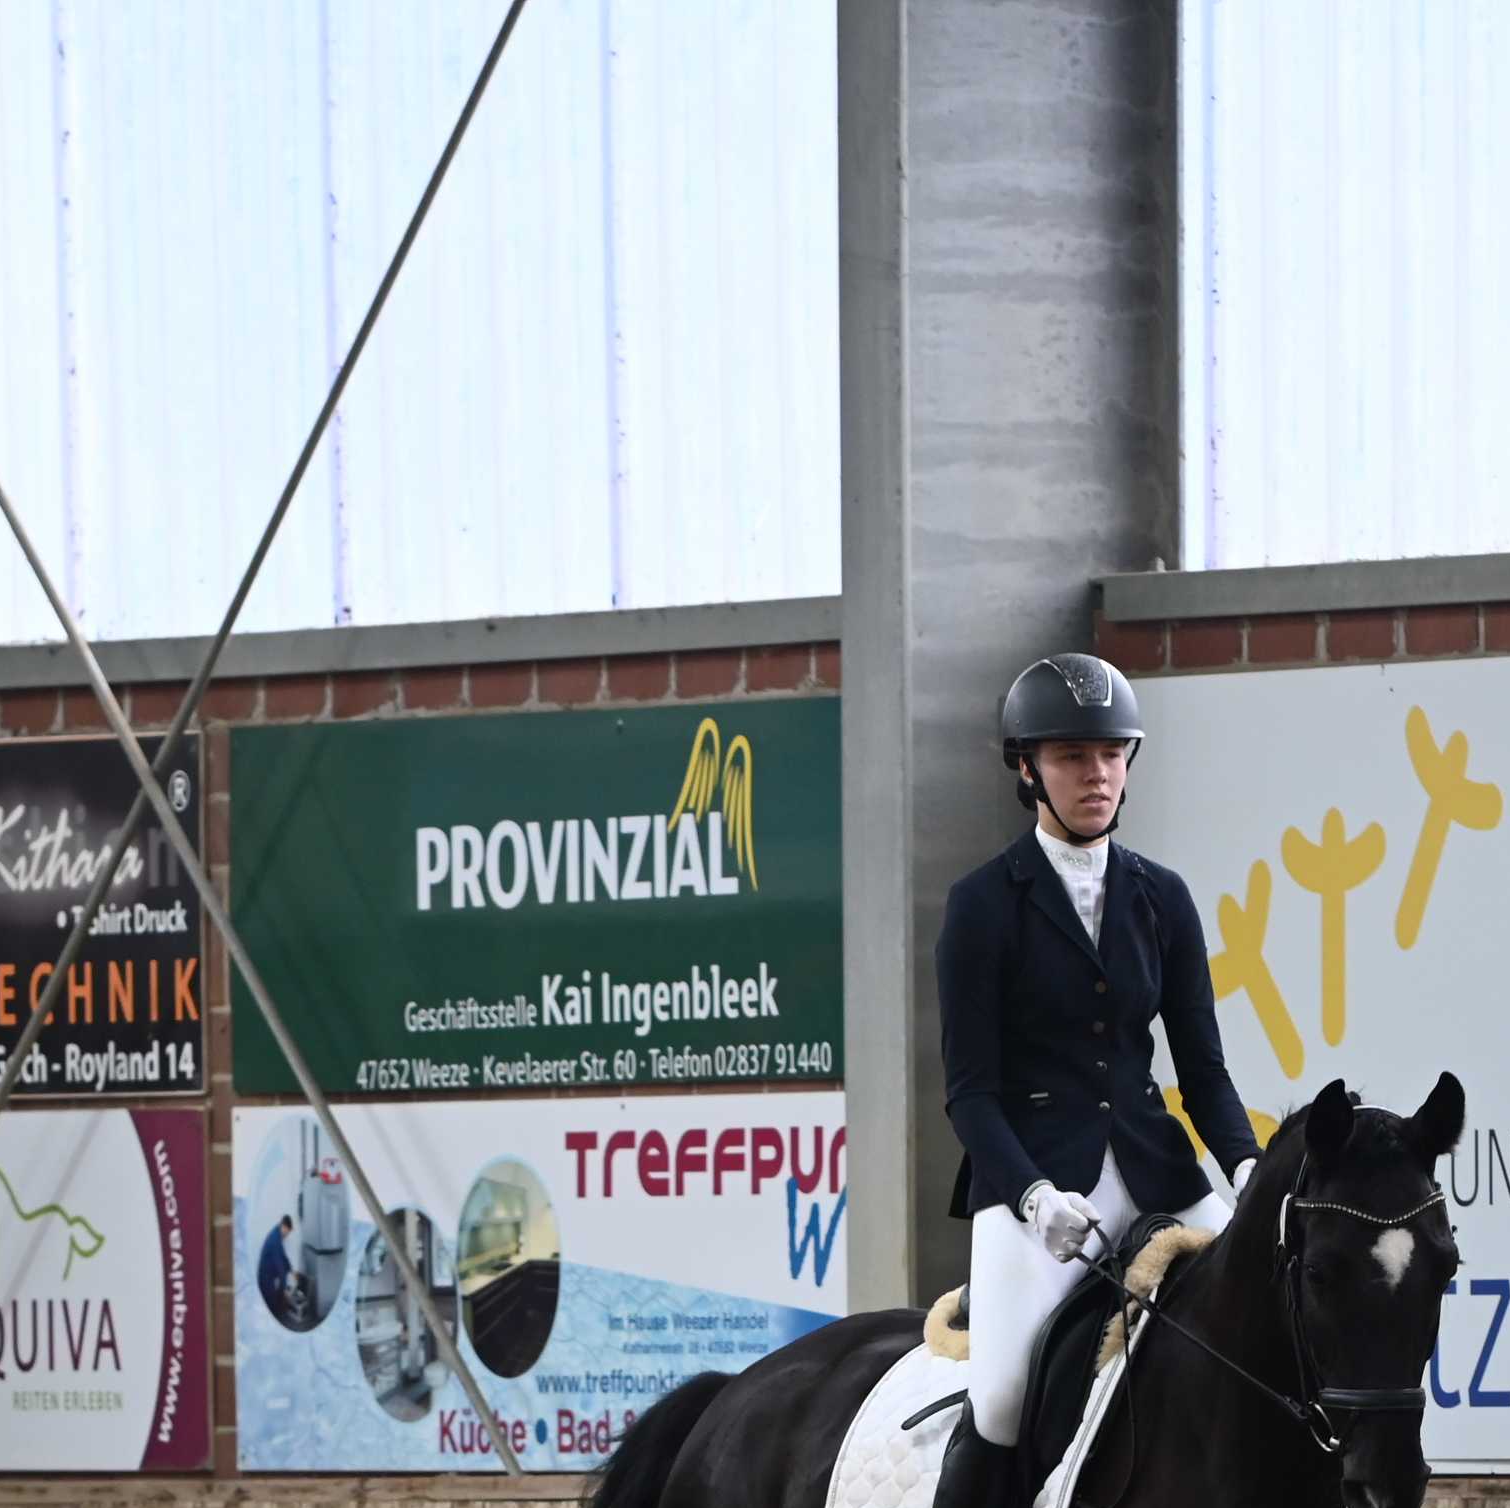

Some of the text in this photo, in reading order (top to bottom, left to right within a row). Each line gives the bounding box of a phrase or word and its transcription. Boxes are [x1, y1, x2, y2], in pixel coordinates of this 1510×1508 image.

[416, 811, 739, 911] PROVINZIAL
[71, 899, 187, 935] Thirt Druck
[404, 962, 780, 1037] Geschäftsstelle Kai Ingenbleek
[64, 1039, 160, 1092] Royland
[165, 1041, 196, 1081] 14
[356, 1041, 833, 1090] 47652 Weeze Kevelaerer Str. 60 Telefon 02837 91440
[153, 1138, 188, 1444] www.equiva.com
[12, 1388, 123, 1411] REITEN ERLEBEN
[556, 1408, 610, 1454] Bad
